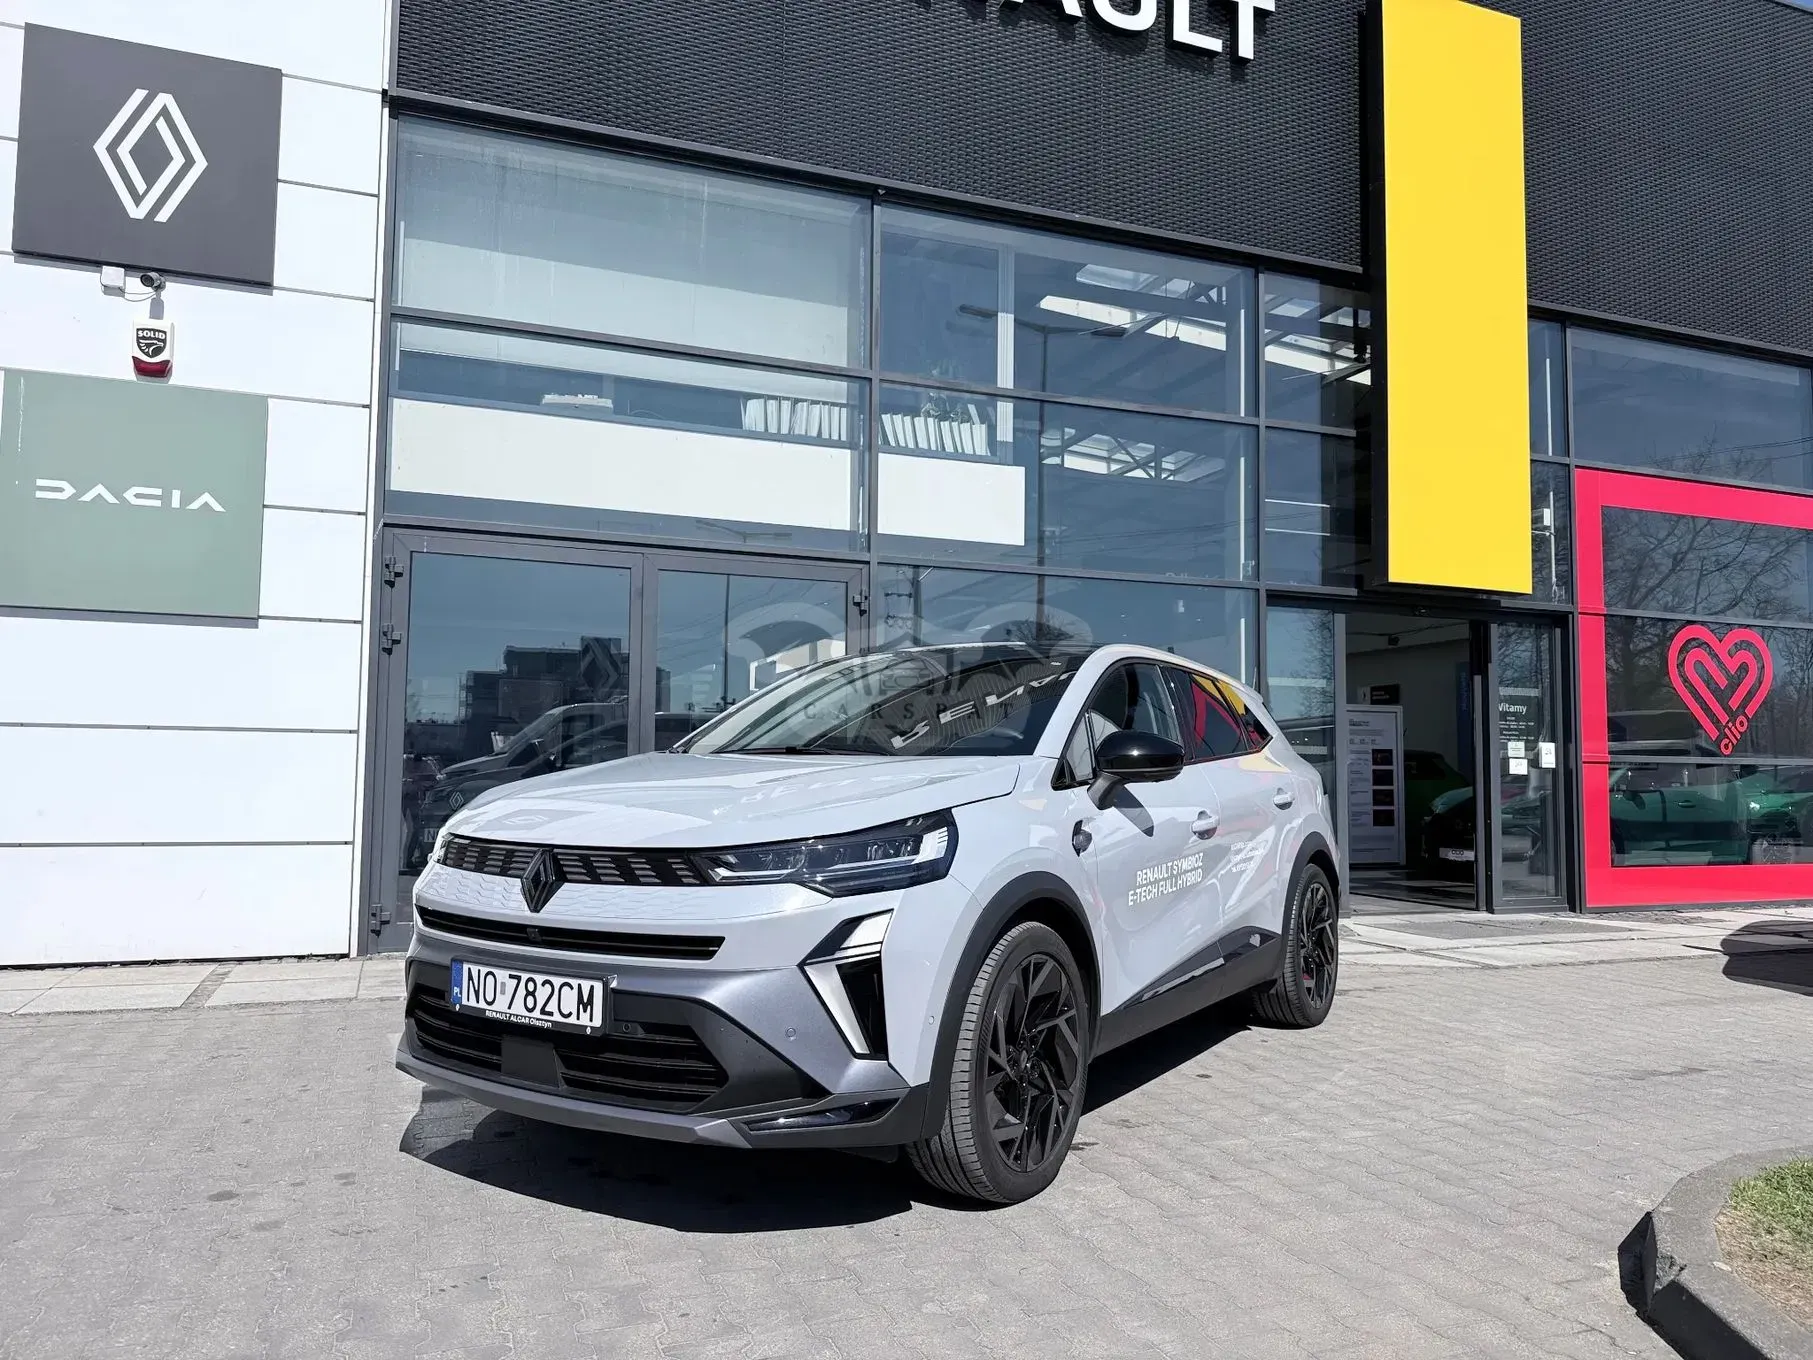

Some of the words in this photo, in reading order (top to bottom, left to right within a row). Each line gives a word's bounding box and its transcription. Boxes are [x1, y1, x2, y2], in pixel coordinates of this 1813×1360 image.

[137, 330, 166, 340] SOLID
[35, 478, 227, 513] DACIA
[1498, 702, 1527, 715] Vitamy
[1719, 714, 1748, 756] clio
[1136, 861, 1173, 886] RENAULT
[1172, 852, 1204, 875] SYMBIOZ
[1128, 883, 1158, 906] E-TECH
[1158, 876, 1177, 896] FULL
[1176, 868, 1203, 890] HYBRID
[453, 986, 462, 998] PL
[466, 966, 498, 1007] NO
[506, 973, 595, 1023] 782CM
[485, 1009, 511, 1020] RENAULT
[510, 1014, 530, 1024] ALCAR
[529, 1018, 552, 1029] Olsztyn
